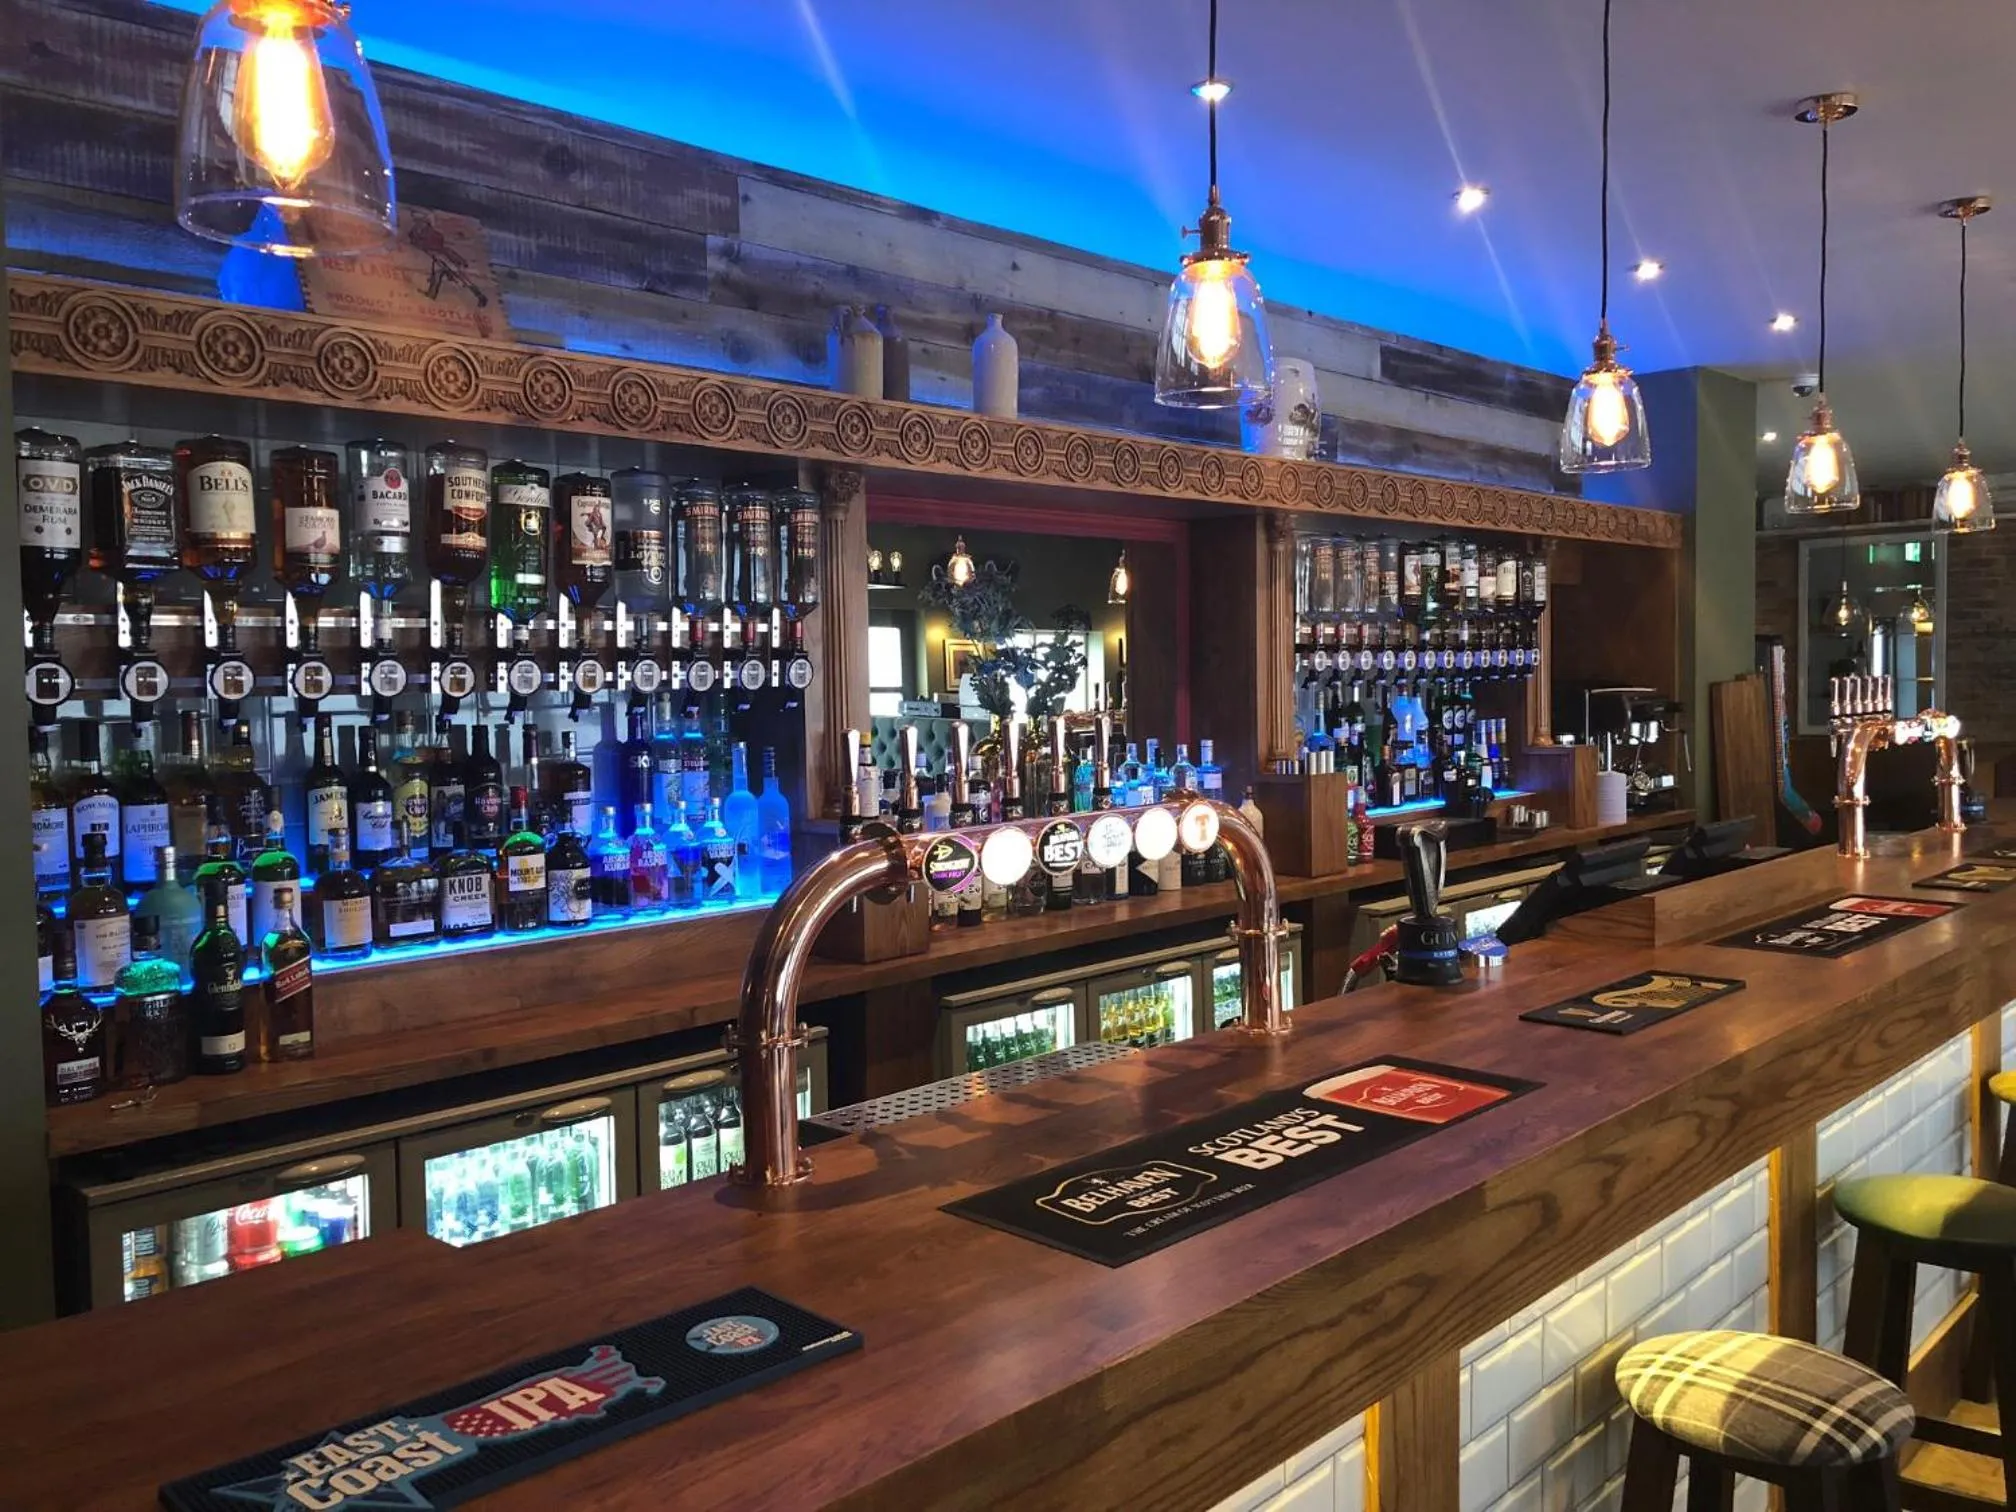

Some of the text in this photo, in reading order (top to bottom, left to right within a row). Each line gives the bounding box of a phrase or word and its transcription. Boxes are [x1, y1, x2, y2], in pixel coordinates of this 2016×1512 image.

[199, 475, 249, 492] BELL'S
[447, 476, 487, 489] SOUTHER
[371, 490, 408, 501] BACARD
[24, 503, 78, 515] DEMERARA
[42, 514, 68, 525] RUM
[1044, 841, 1083, 863] BEST
[448, 876, 482, 896] KNOB
[1188, 1107, 1320, 1157] SCOTLAND'S
[1214, 1114, 1366, 1170] BEST
[1060, 1167, 1183, 1213] BELHAVEN
[1125, 1187, 1181, 1208] BEST
[480, 1376, 606, 1430] IPA
[288, 1420, 411, 1477] EAST
[286, 1430, 464, 1511] Coast
